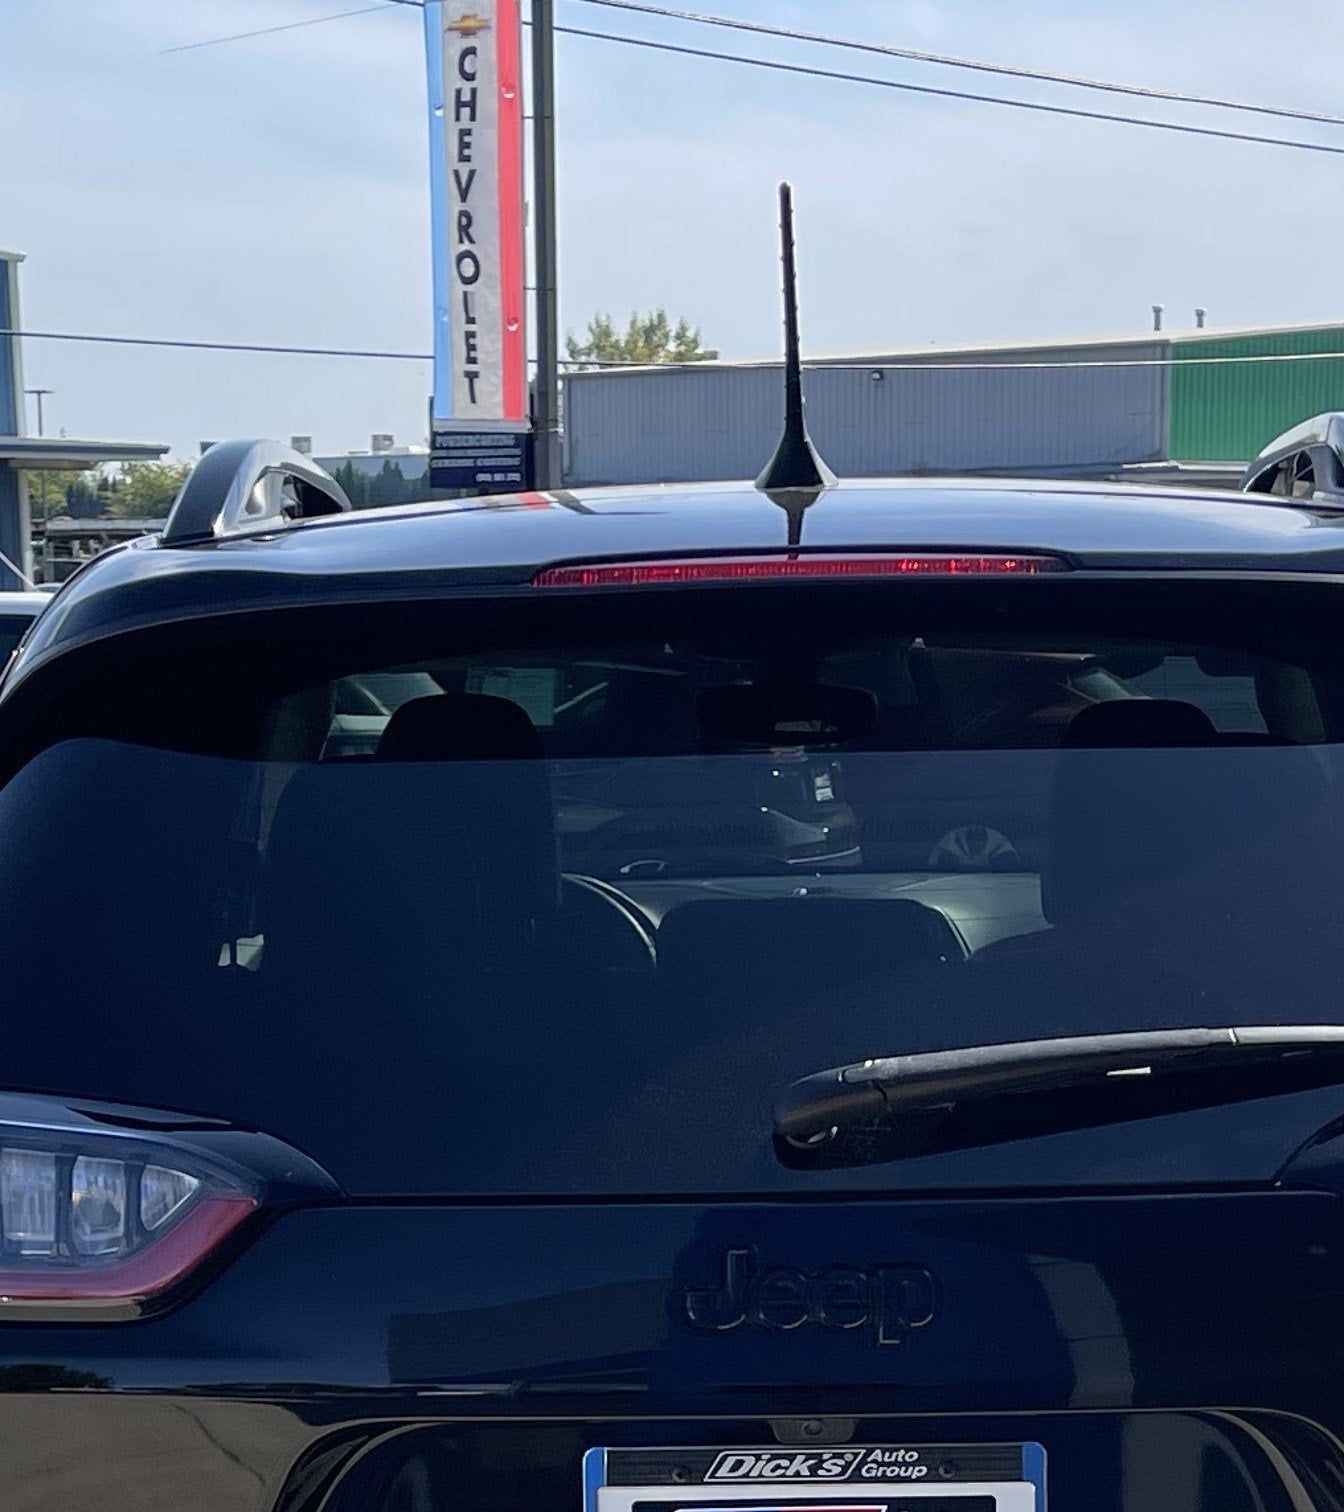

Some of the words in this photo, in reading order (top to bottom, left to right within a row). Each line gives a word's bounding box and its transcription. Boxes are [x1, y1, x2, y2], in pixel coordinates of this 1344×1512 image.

[453, 46, 481, 404] CHEVROLET
[683, 1249, 935, 1345] Jeep
[860, 1463, 928, 1480] Group
[867, 1448, 919, 1463] Auto
